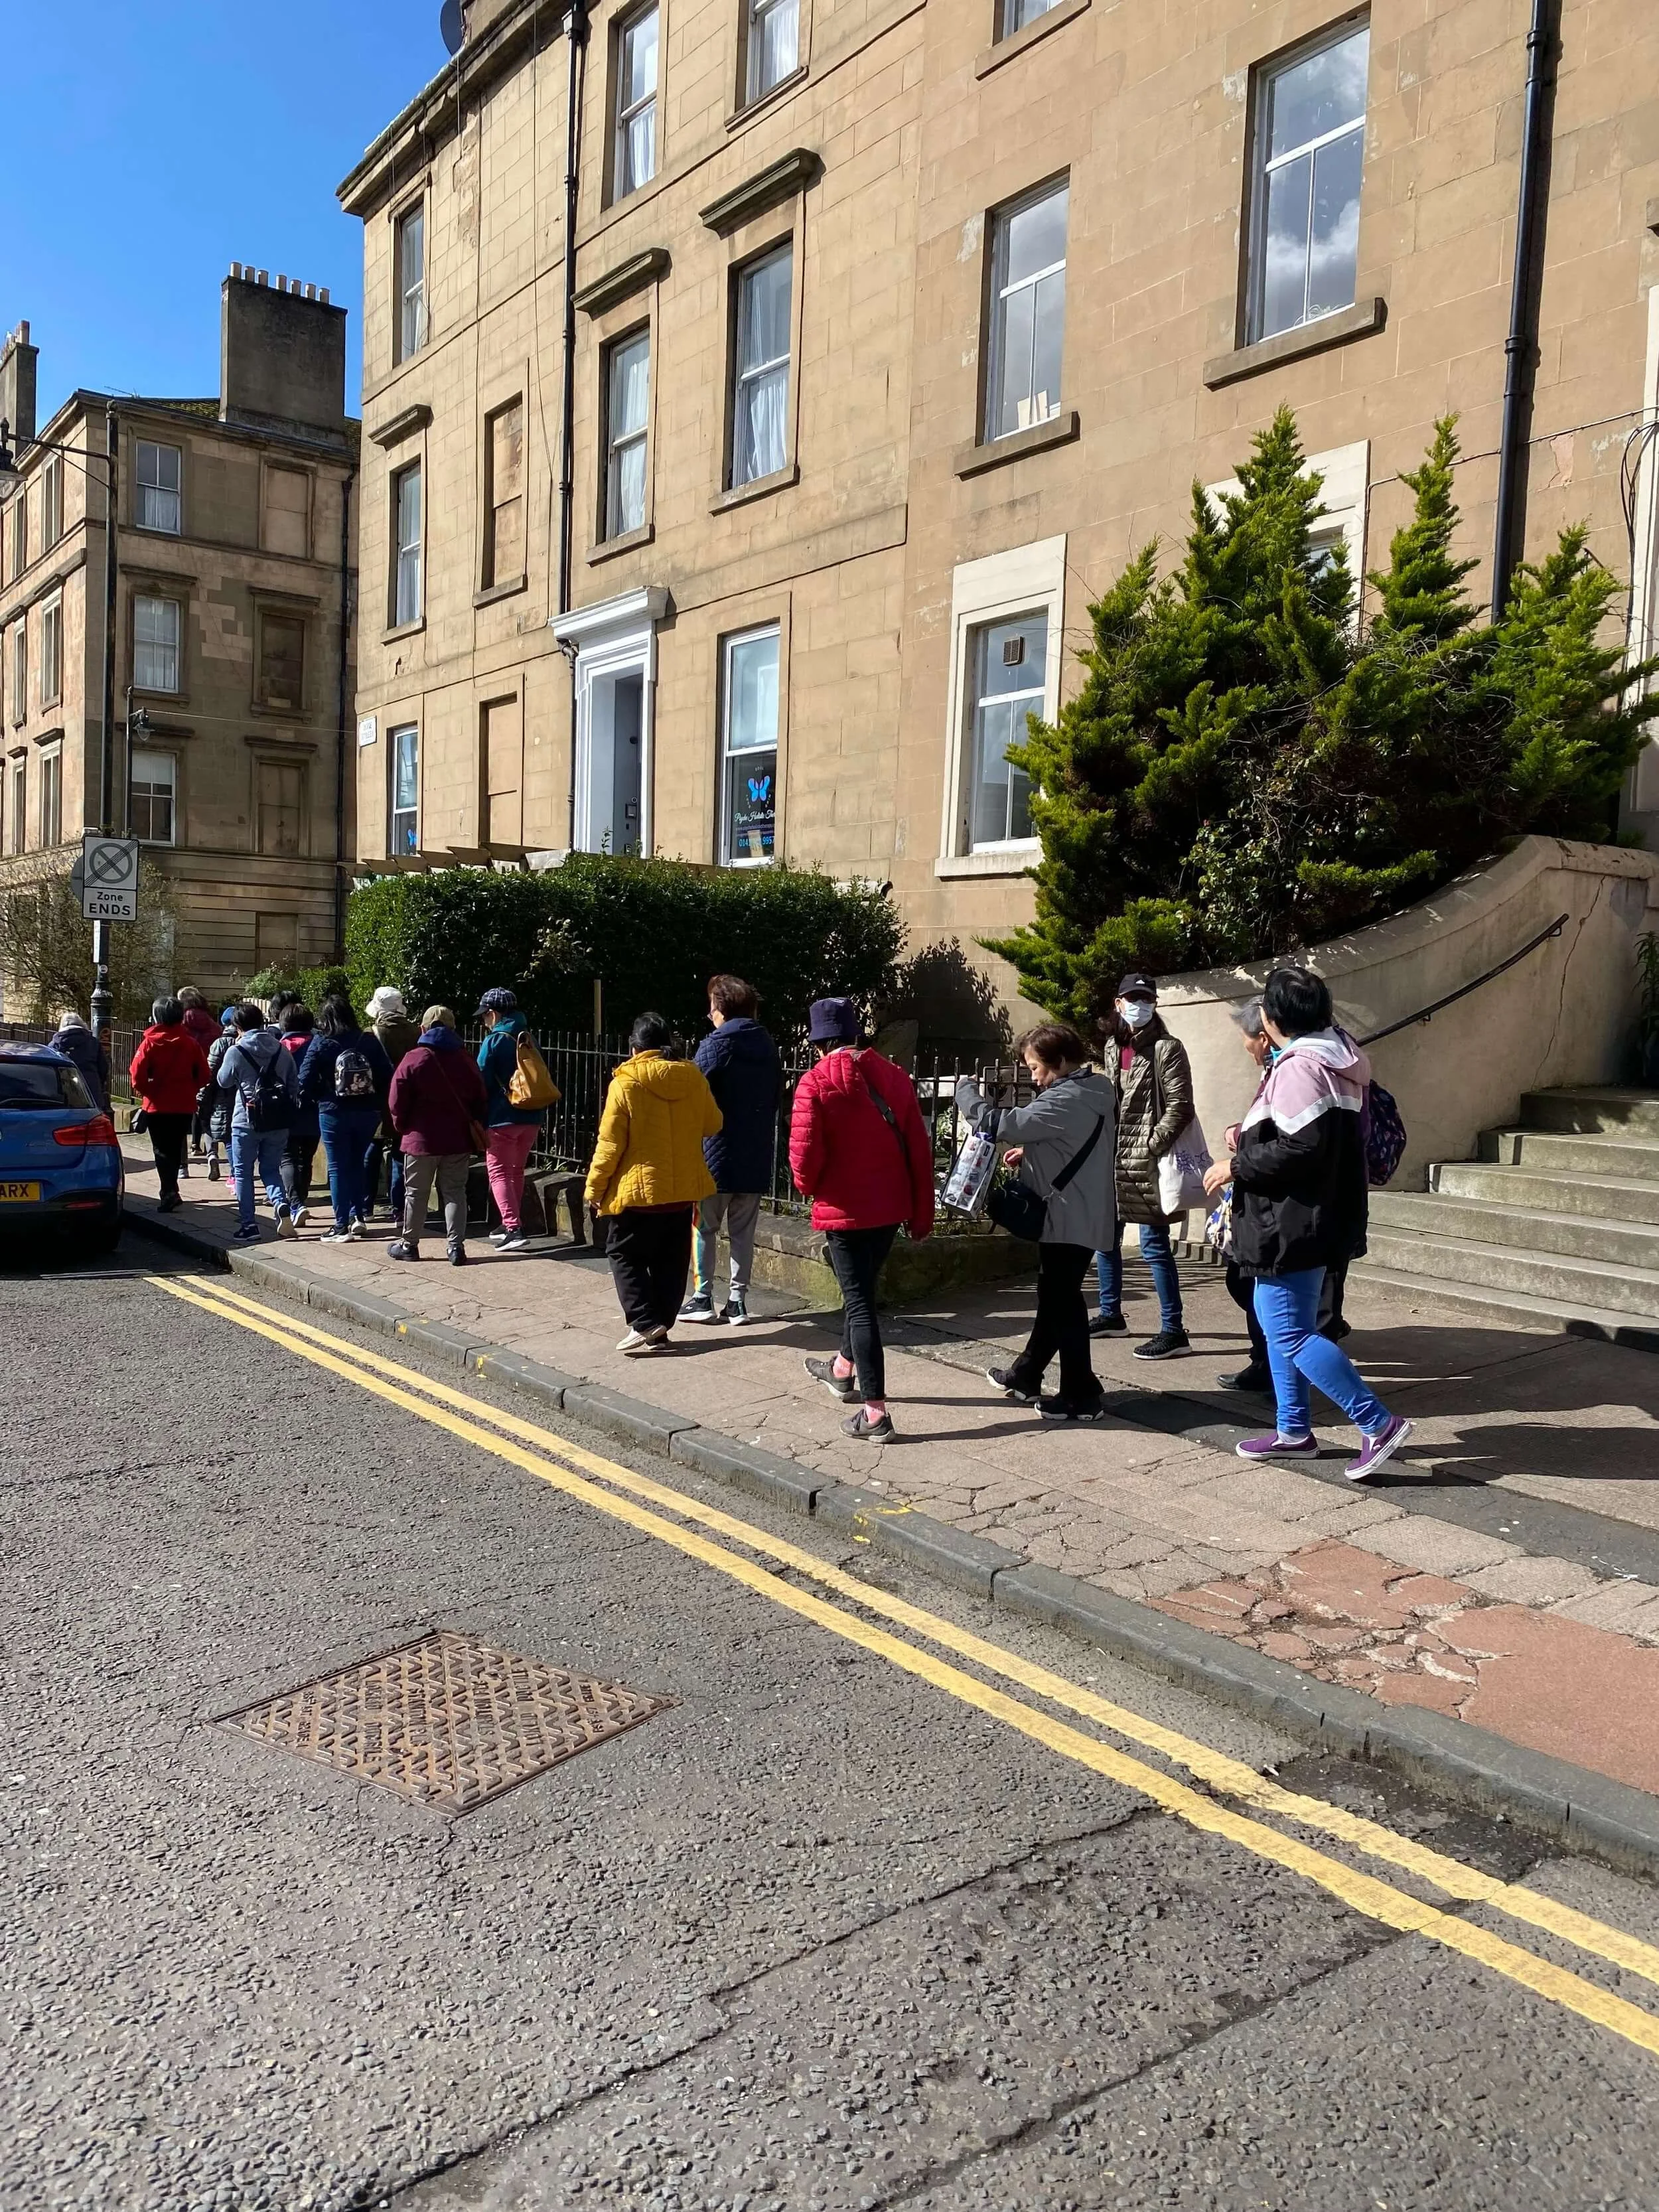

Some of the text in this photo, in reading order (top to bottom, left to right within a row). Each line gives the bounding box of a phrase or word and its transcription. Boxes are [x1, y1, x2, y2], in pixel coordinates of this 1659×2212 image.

[97, 891, 123, 901] Zone
[89, 903, 131, 915] ENDS
[0, 1184, 29, 1197] ARX
